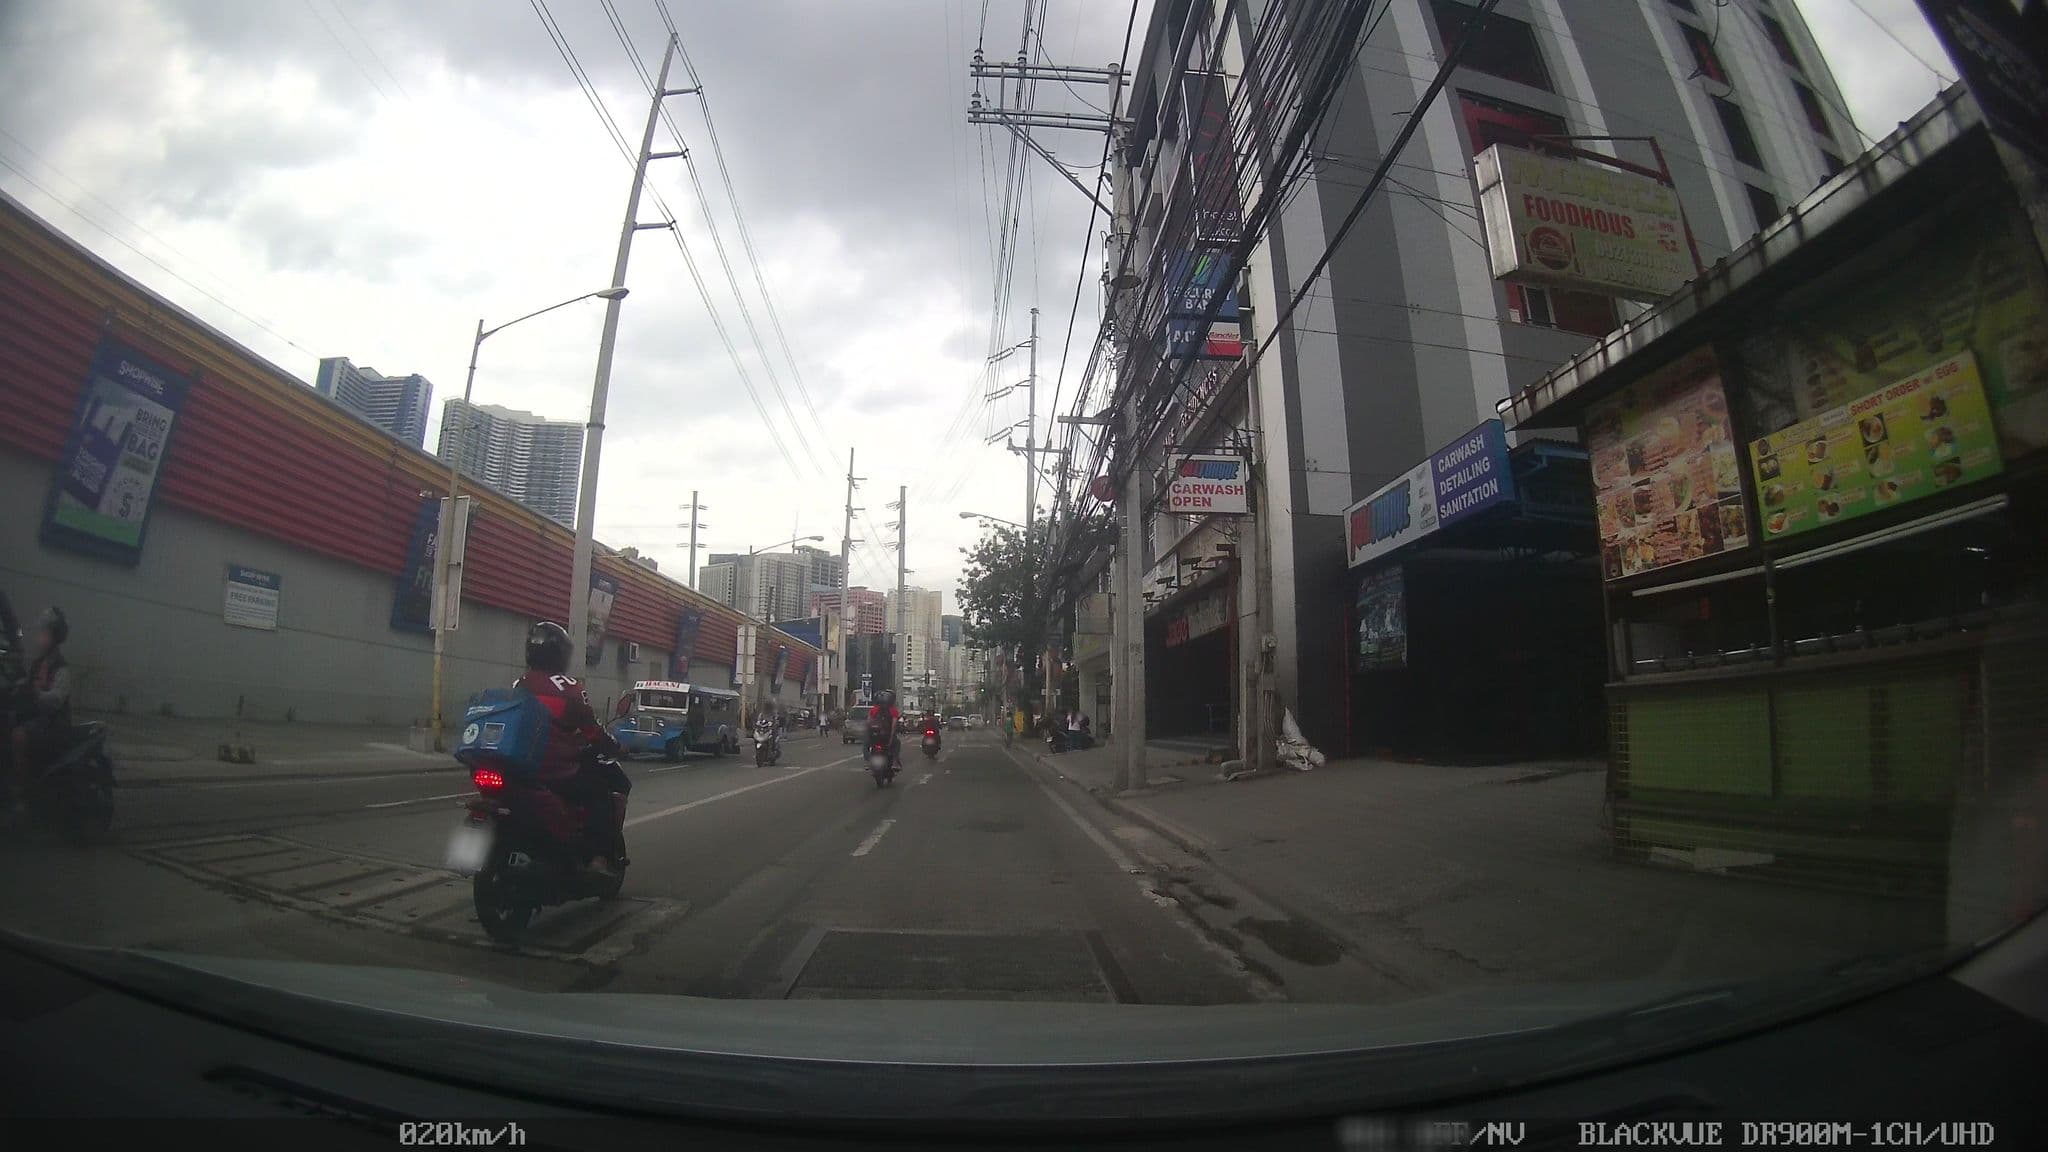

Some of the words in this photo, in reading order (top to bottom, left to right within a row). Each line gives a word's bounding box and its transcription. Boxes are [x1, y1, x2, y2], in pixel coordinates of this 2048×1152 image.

[1850, 394, 1883, 416] SHORT
[1886, 378, 1921, 401] ORDER
[136, 407, 168, 432] BRING
[127, 434, 160, 461] BAG
[1438, 433, 1485, 473] CARWASH
[1172, 484, 1244, 495] CARWASH
[1440, 456, 1491, 496] DETAILING
[1172, 496, 1212, 507] OPEN
[1440, 478, 1499, 519] SANITATION
